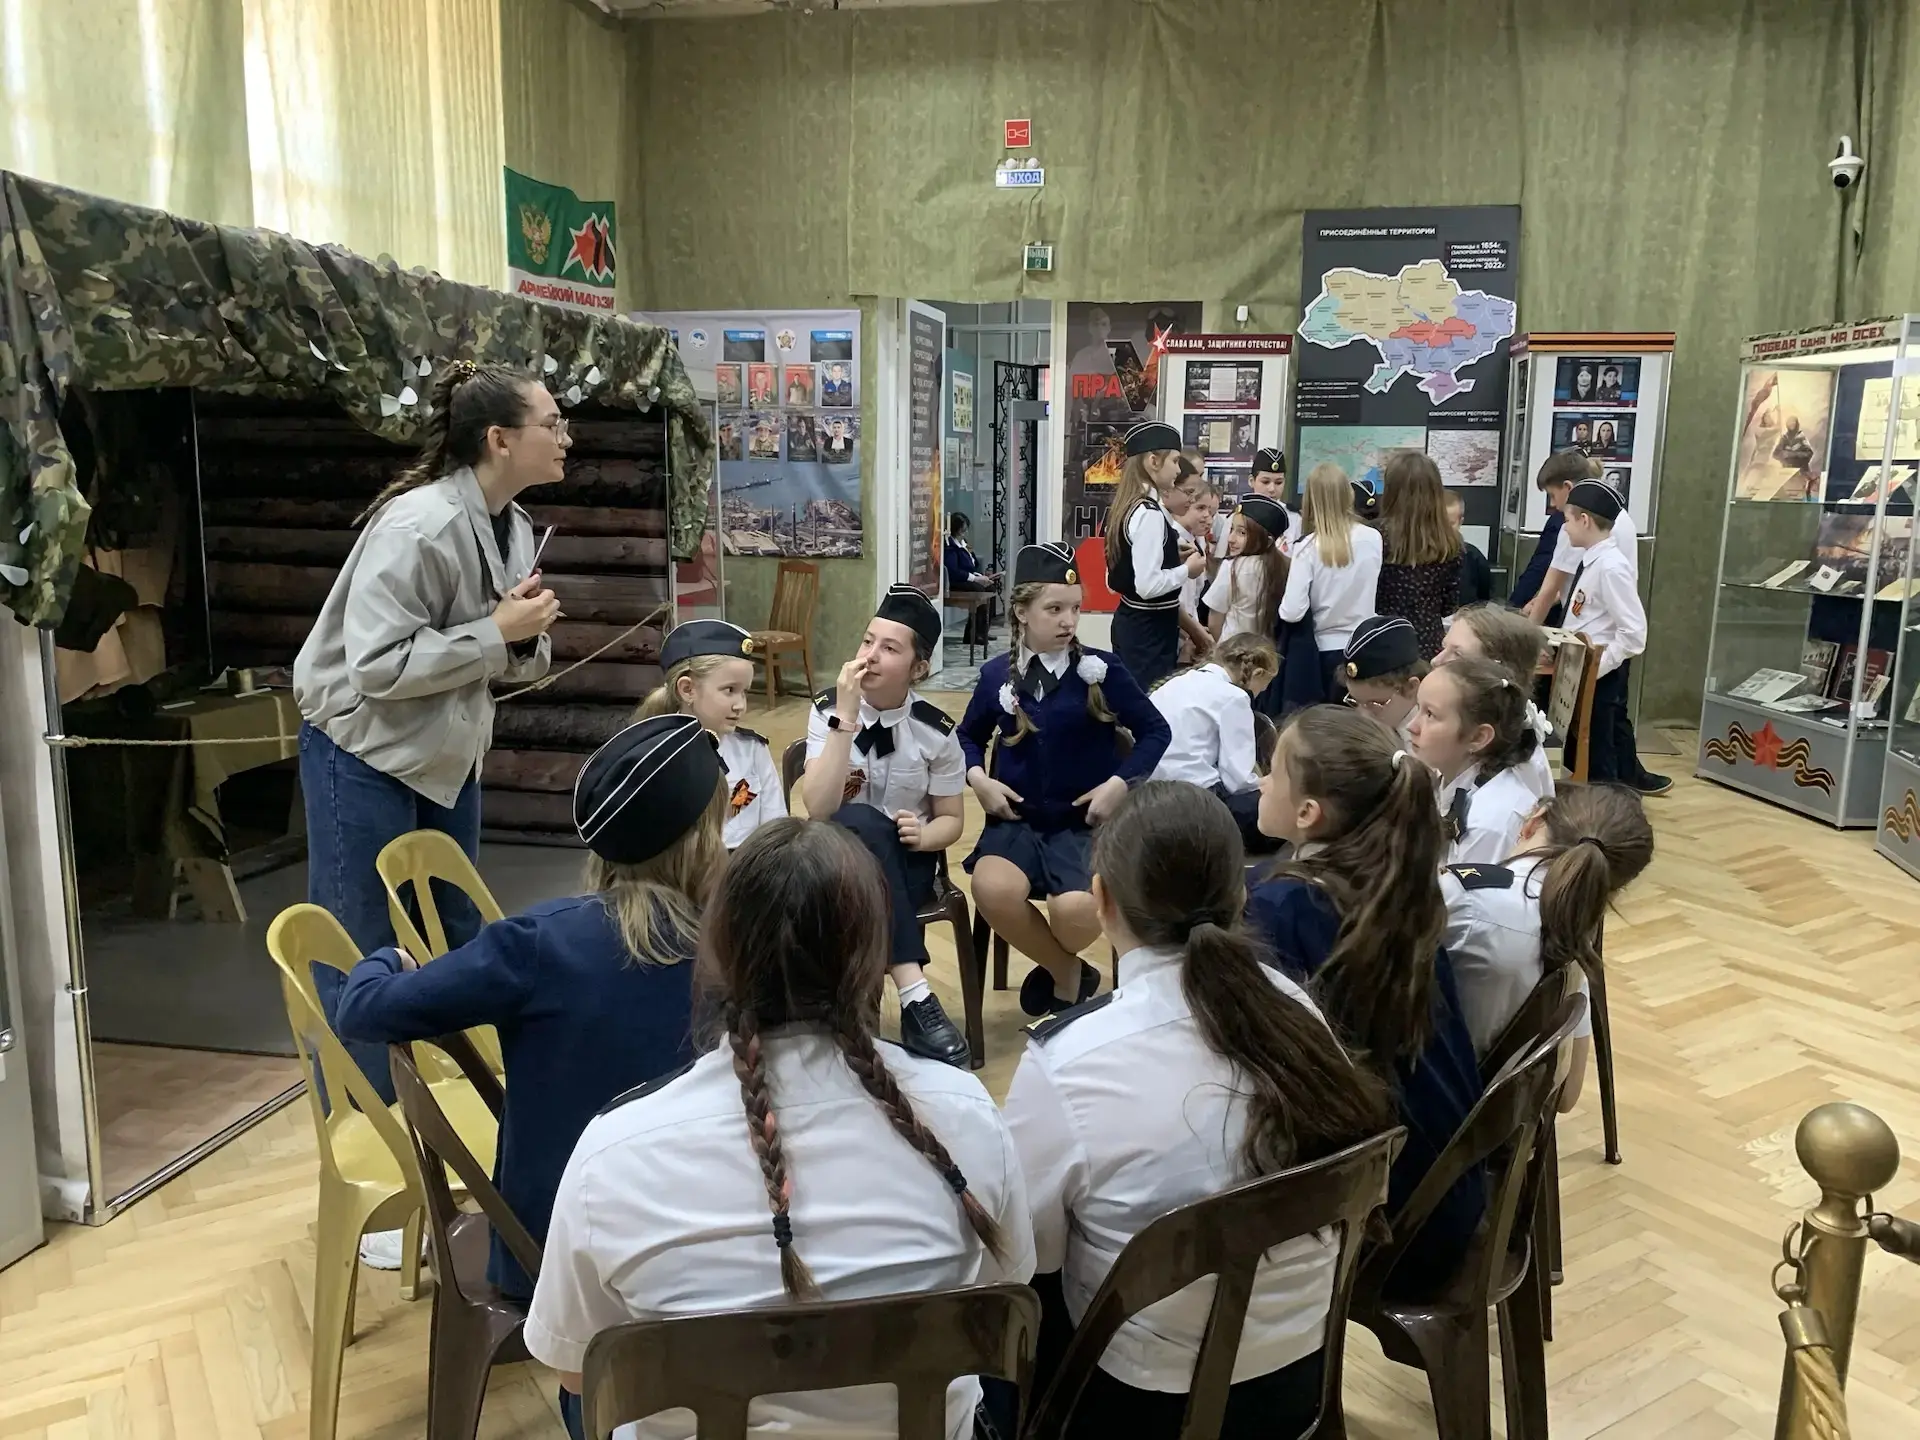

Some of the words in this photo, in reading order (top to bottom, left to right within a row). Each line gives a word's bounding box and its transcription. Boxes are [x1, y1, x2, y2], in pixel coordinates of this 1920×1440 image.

[1001, 171, 1040, 184] ЫХОД
[1389, 227, 1436, 235] ТЕРРИТОРИИ
[1166, 339, 1187, 348] СЛАВА
[1188, 339, 1206, 350] ВАМ,
[1207, 339, 1247, 350] ЗАЩИТНИКИ
[1247, 340, 1288, 349] ОТЕЧЕСТВА!
[1800, 336, 1826, 348] ОДНА
[1830, 331, 1848, 344] НА
